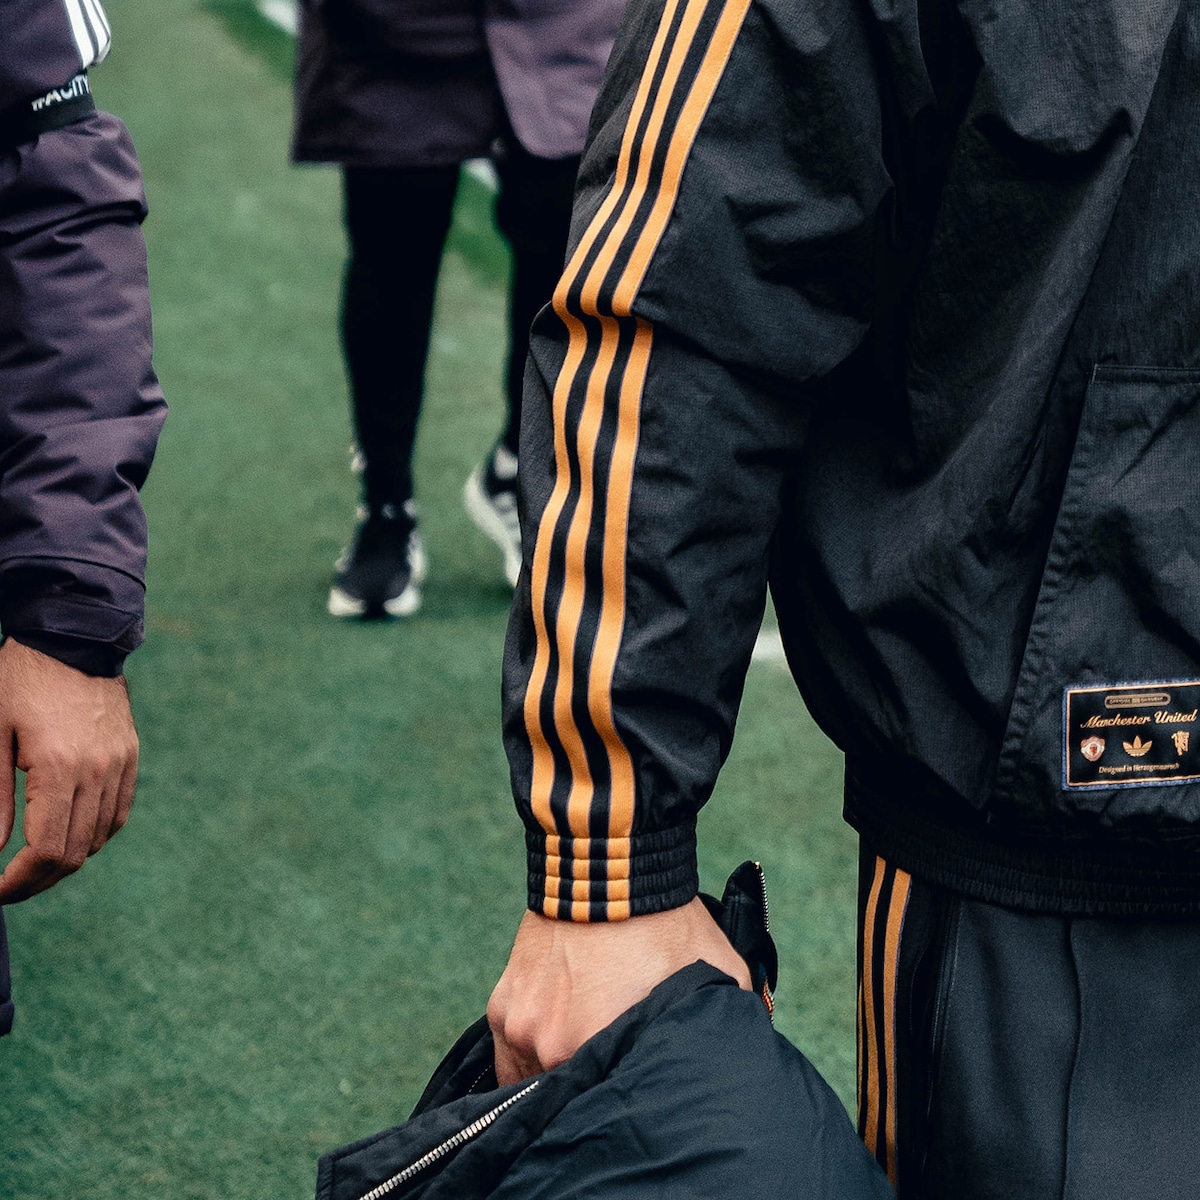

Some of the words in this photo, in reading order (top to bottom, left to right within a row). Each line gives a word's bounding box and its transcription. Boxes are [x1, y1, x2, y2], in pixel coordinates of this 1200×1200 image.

[1080, 713, 1151, 729] Manchester
[1154, 709, 1198, 724] United
[1099, 764, 1126, 775] Designed
